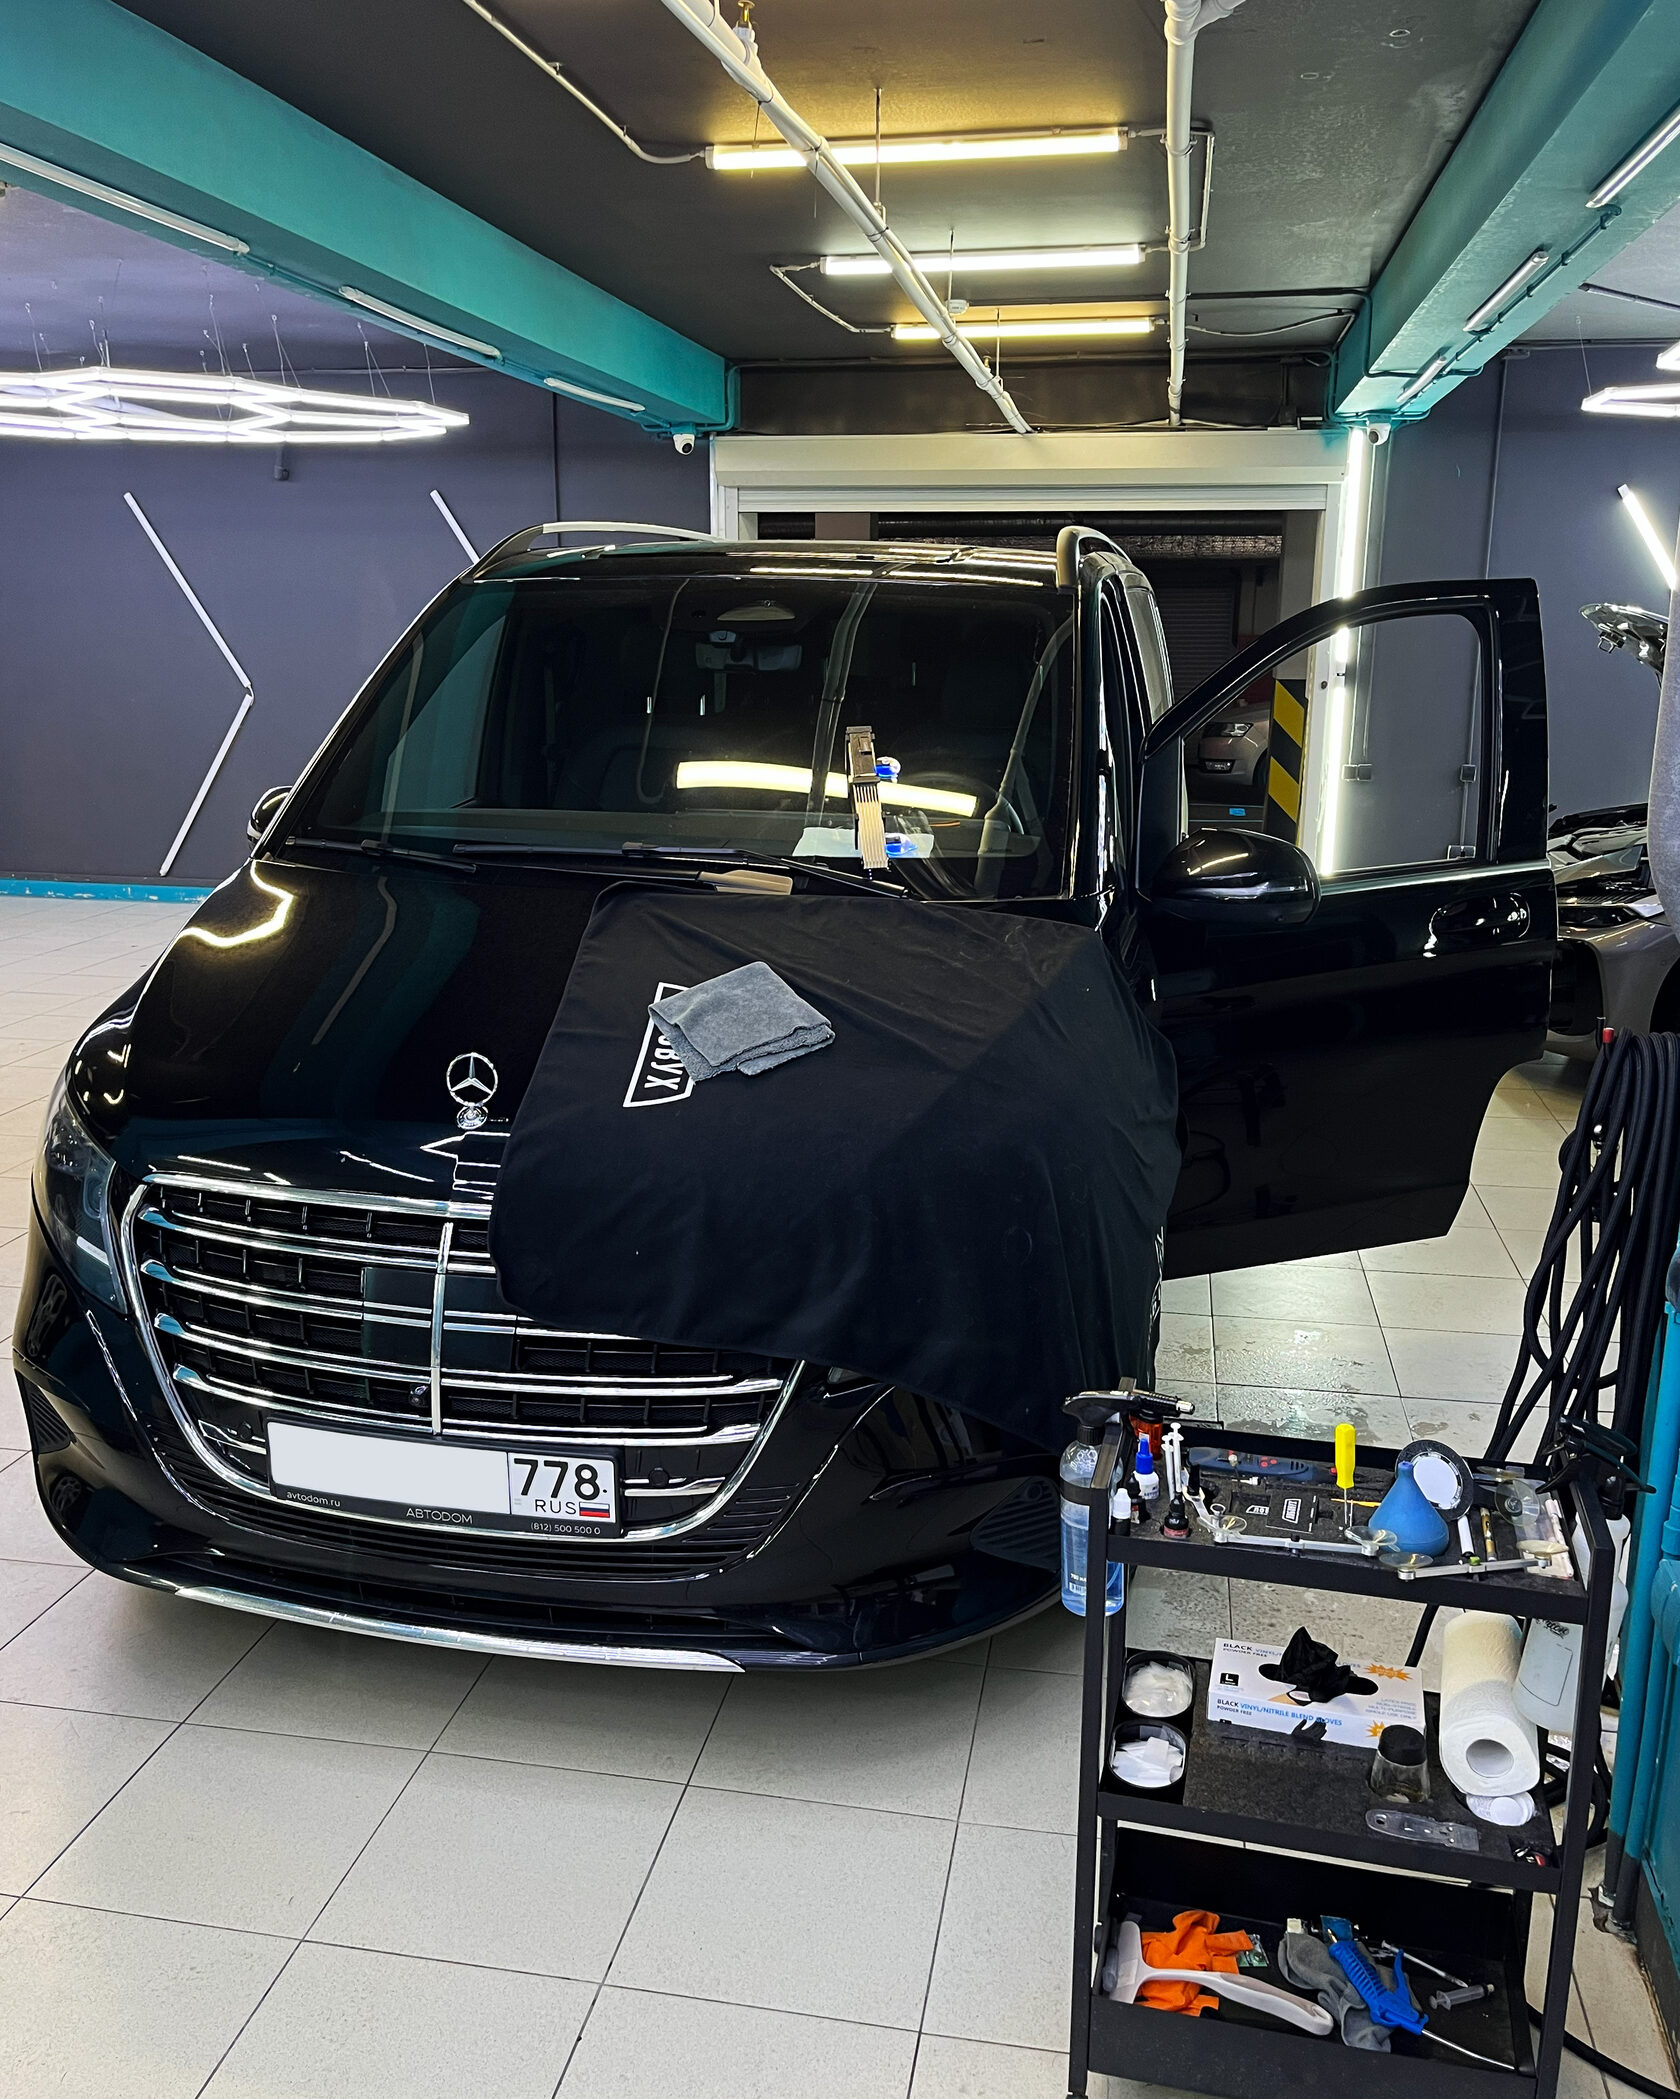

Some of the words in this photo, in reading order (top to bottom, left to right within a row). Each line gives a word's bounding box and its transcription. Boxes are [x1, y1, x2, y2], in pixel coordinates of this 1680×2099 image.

[514, 1458, 600, 1500] 778
[286, 1491, 341, 1507] avtodom.ru
[535, 1499, 577, 1515] RUS
[530, 1522, 552, 1532] (812)
[554, 1524, 572, 1533] 500
[574, 1525, 592, 1534] 500
[594, 1527, 601, 1535] 0
[1223, 1643, 1253, 1651] BLACK
[1225, 1673, 1234, 1682] L
[1216, 1705, 1239, 1713] POWDER
[1217, 1698, 1239, 1708] BLACK
[1240, 1703, 1290, 1718] VINYL/NITRILE
[1291, 1712, 1314, 1721] BLEND
[1315, 1717, 1343, 1726] GLOVES
